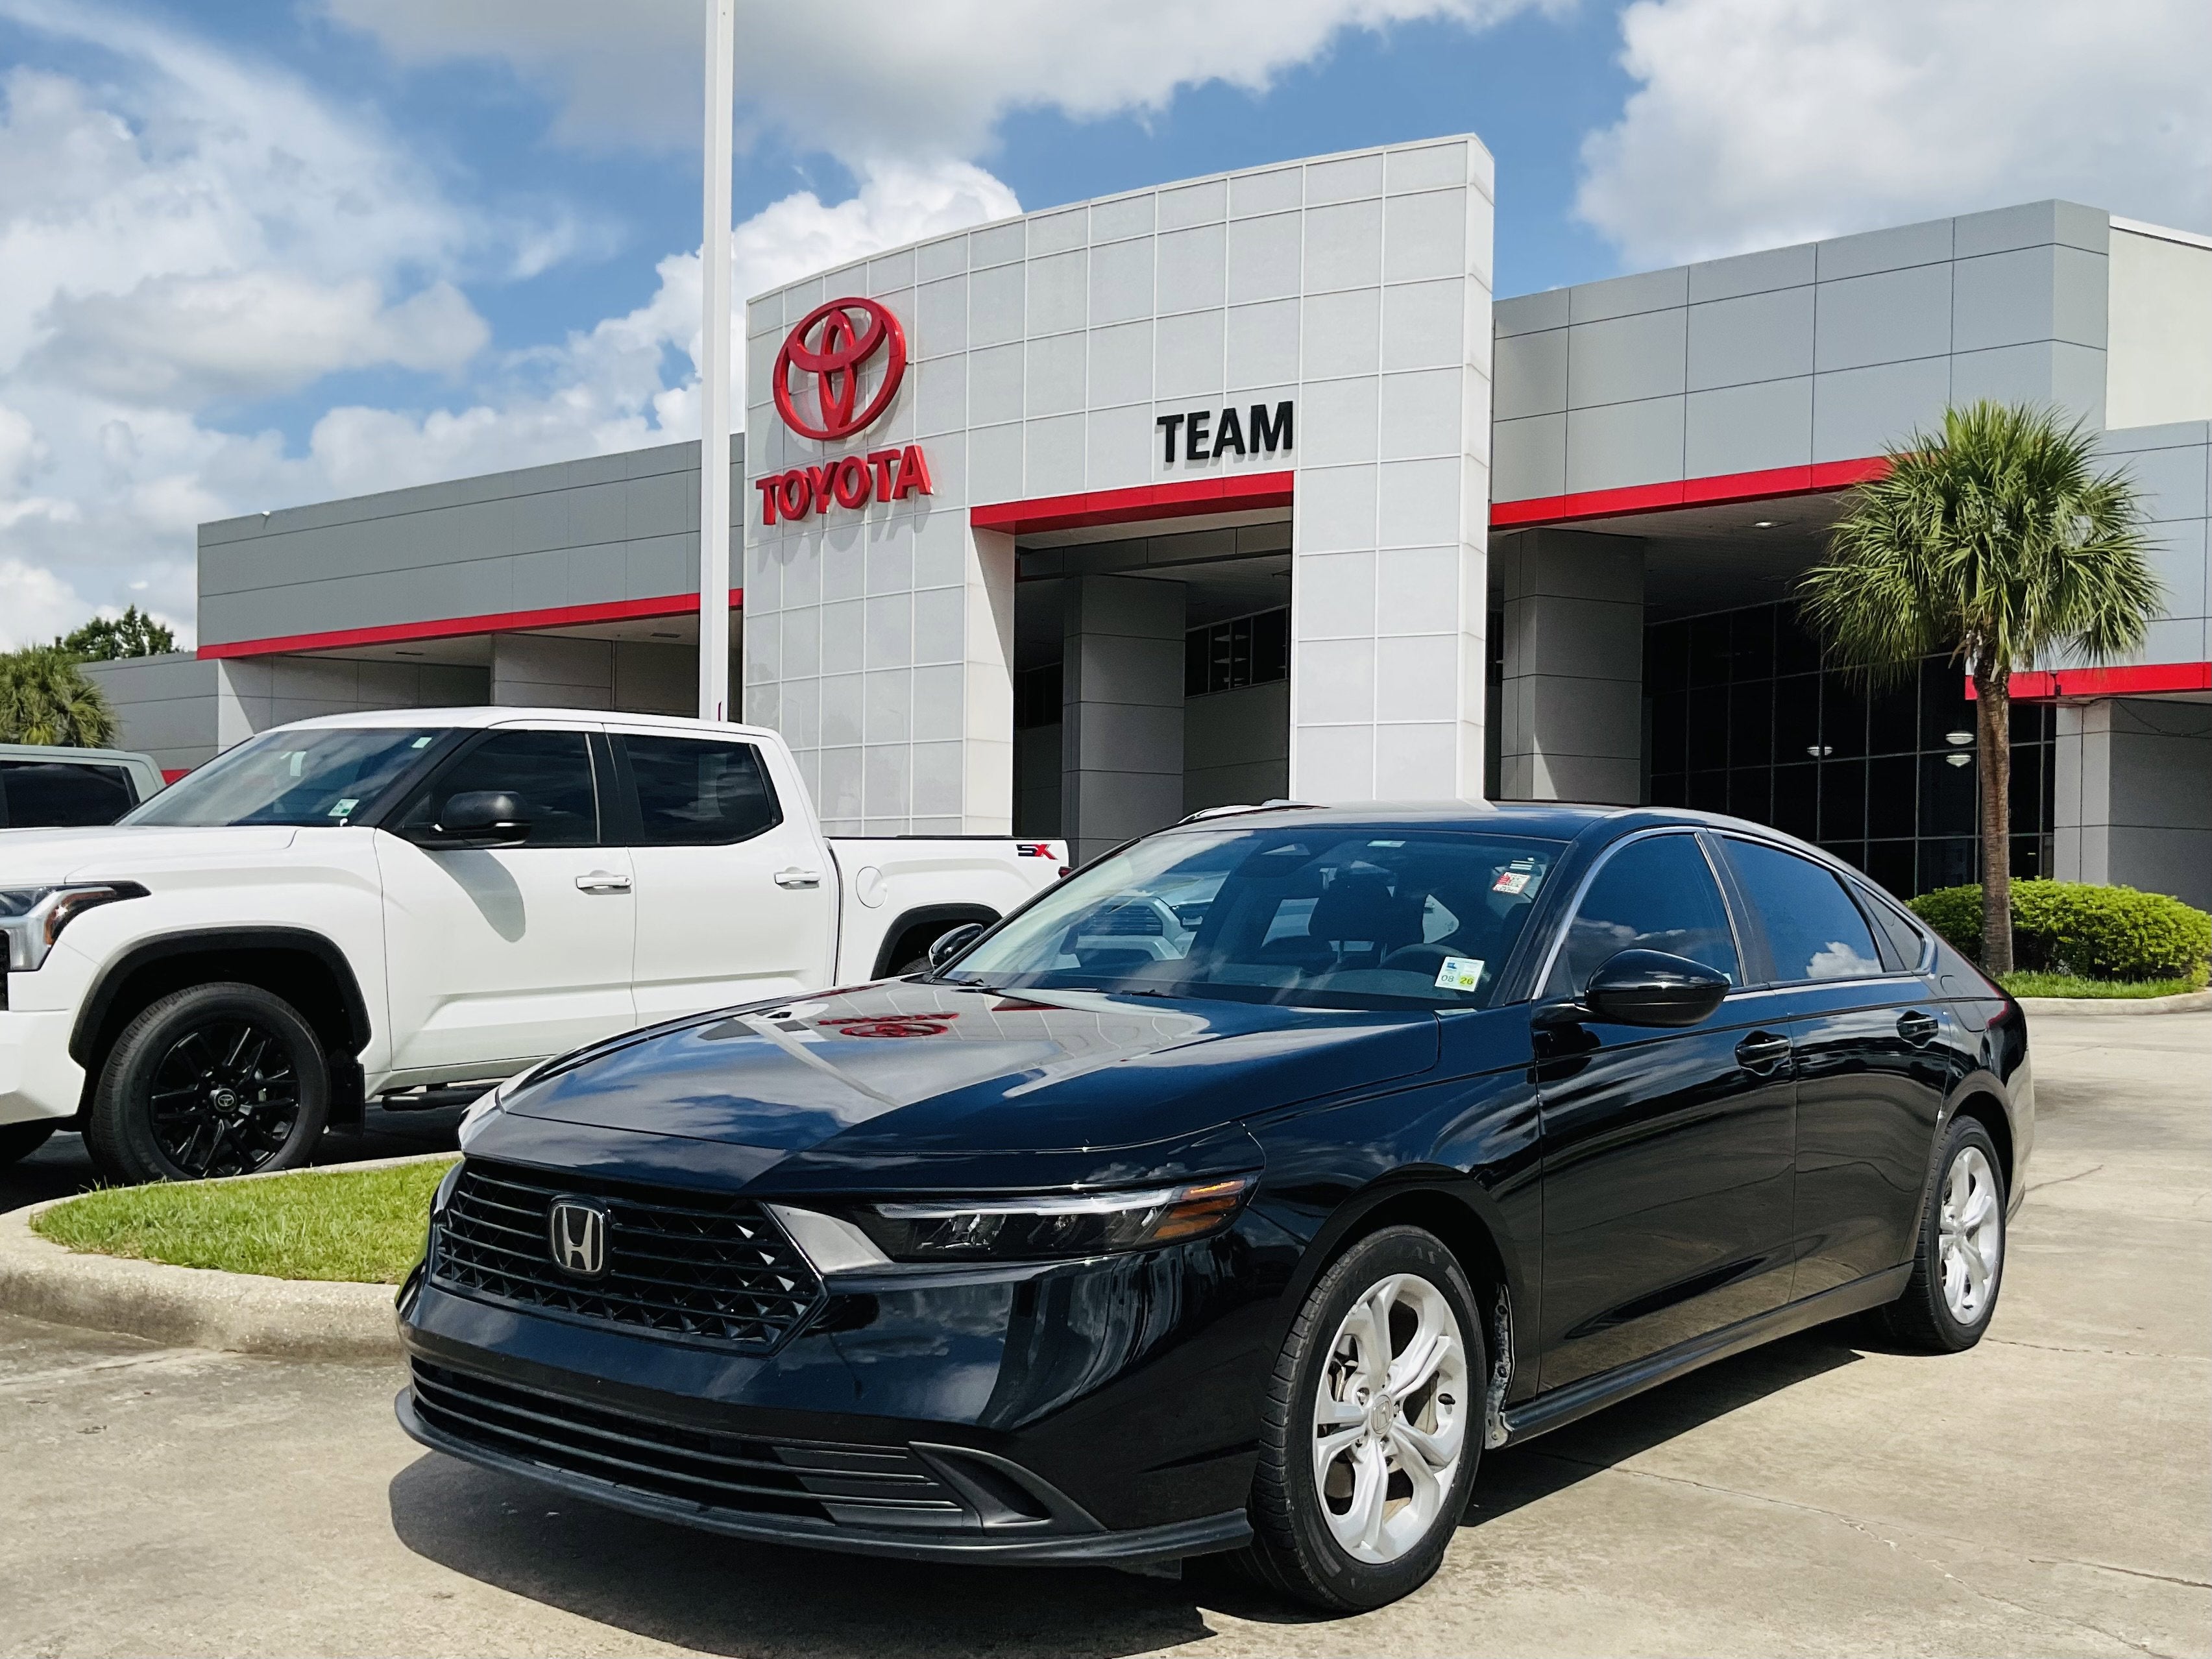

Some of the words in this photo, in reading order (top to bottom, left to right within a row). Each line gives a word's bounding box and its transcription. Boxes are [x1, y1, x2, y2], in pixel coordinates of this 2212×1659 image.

[1157, 401, 1293, 463] TEAM
[756, 445, 933, 525] TOYOTA
[1016, 843, 1058, 860] SX
